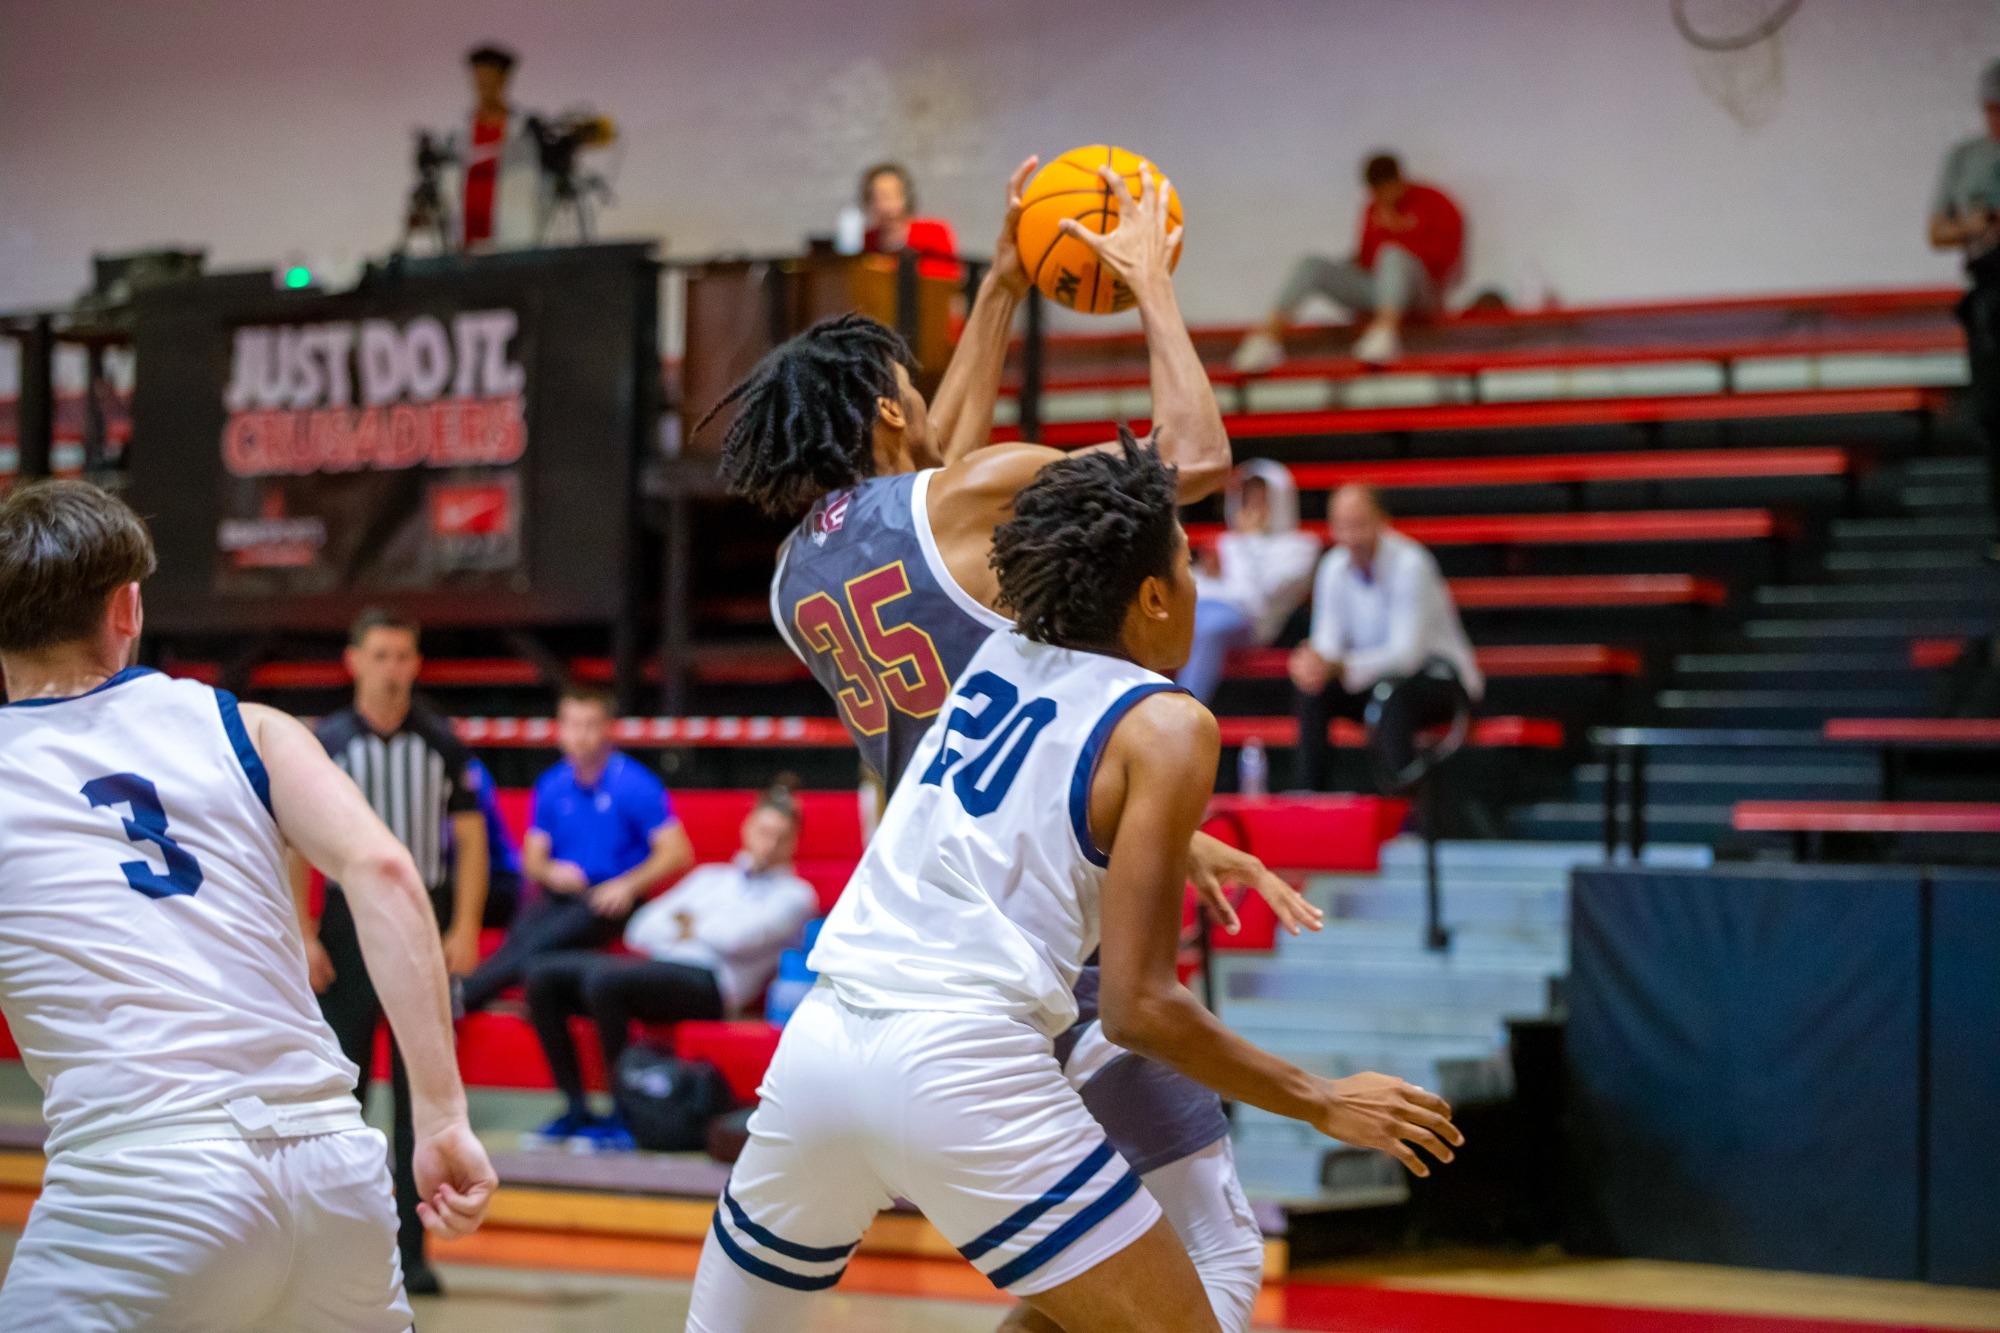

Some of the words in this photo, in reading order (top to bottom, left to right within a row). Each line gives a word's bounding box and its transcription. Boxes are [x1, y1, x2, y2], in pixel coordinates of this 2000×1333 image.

[224, 324, 351, 411] JUST
[358, 317, 450, 405] DO
[222, 397, 528, 476] CRUSADERS
[795, 560, 952, 736] 35
[920, 670, 1057, 818] 20
[79, 773, 205, 899] 3
